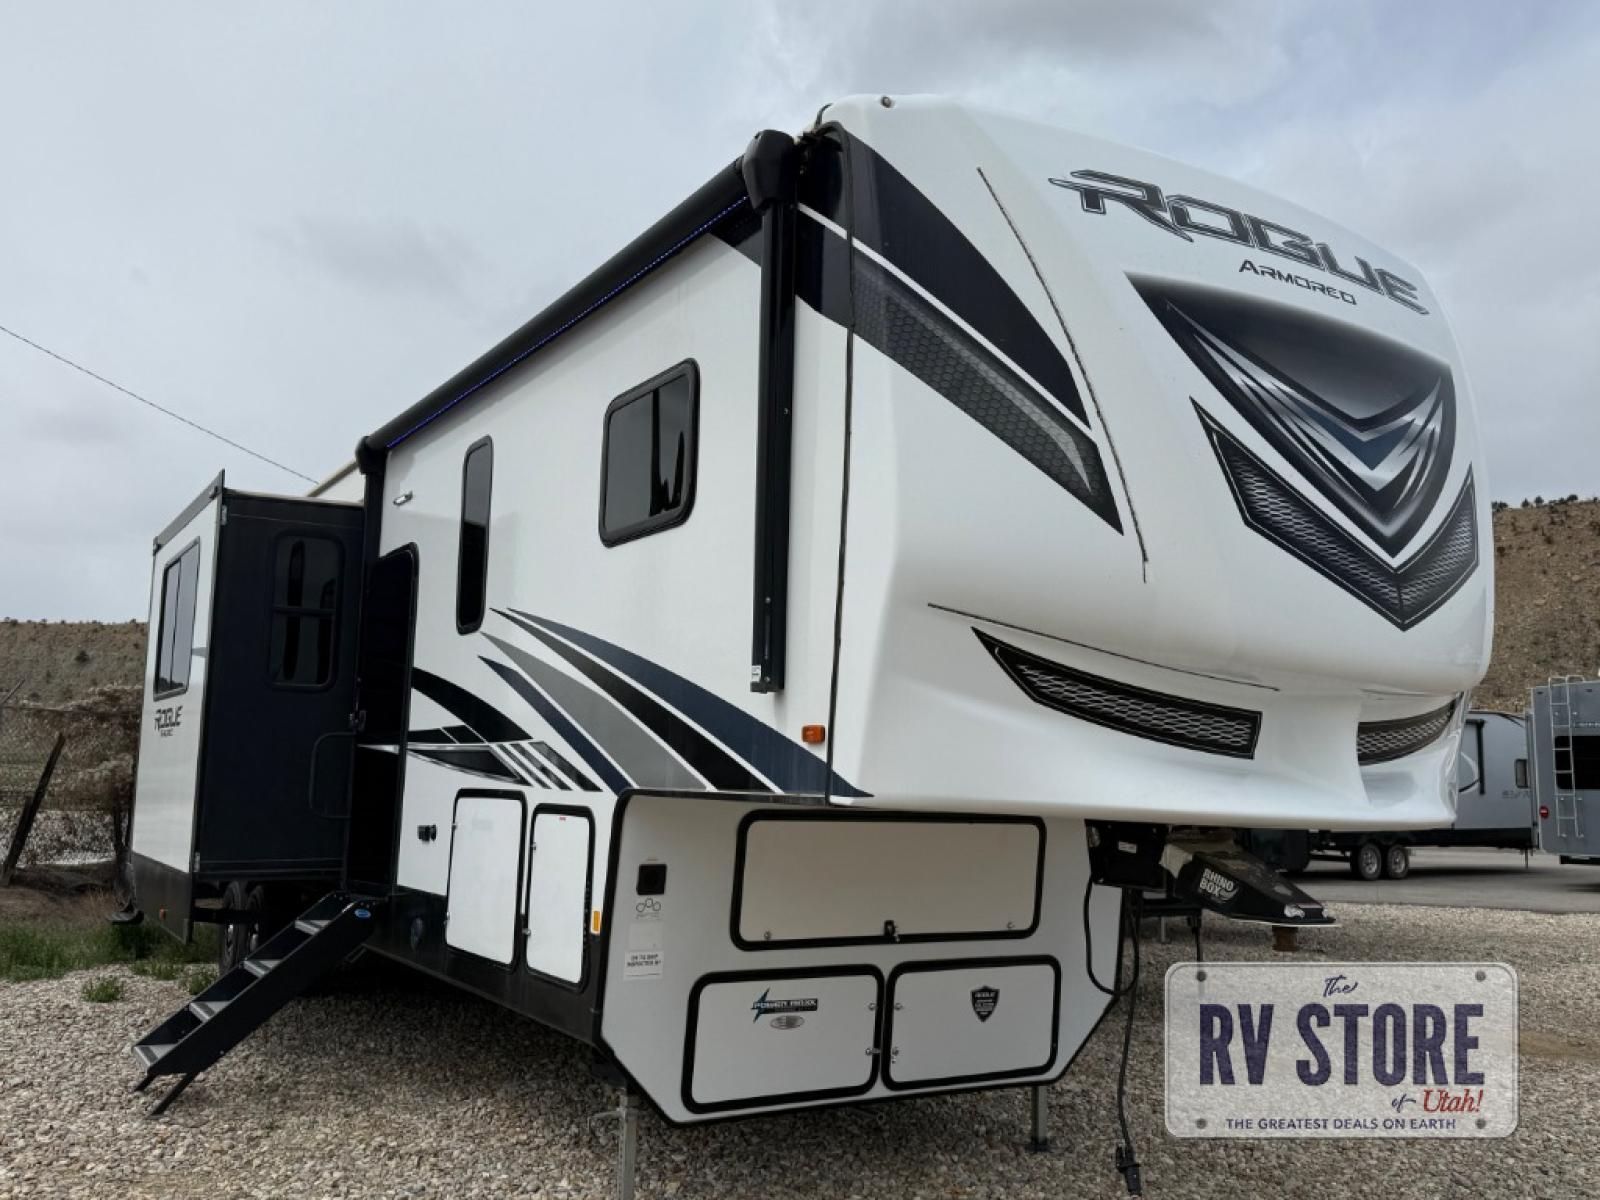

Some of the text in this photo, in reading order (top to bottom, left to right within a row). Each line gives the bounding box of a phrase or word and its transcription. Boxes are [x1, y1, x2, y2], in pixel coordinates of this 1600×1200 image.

[1048, 168, 1430, 316] ROGUE
[1238, 258, 1358, 306] ARMORED
[1200, 878, 1221, 896] BOX
[1203, 868, 1234, 892] RHINO
